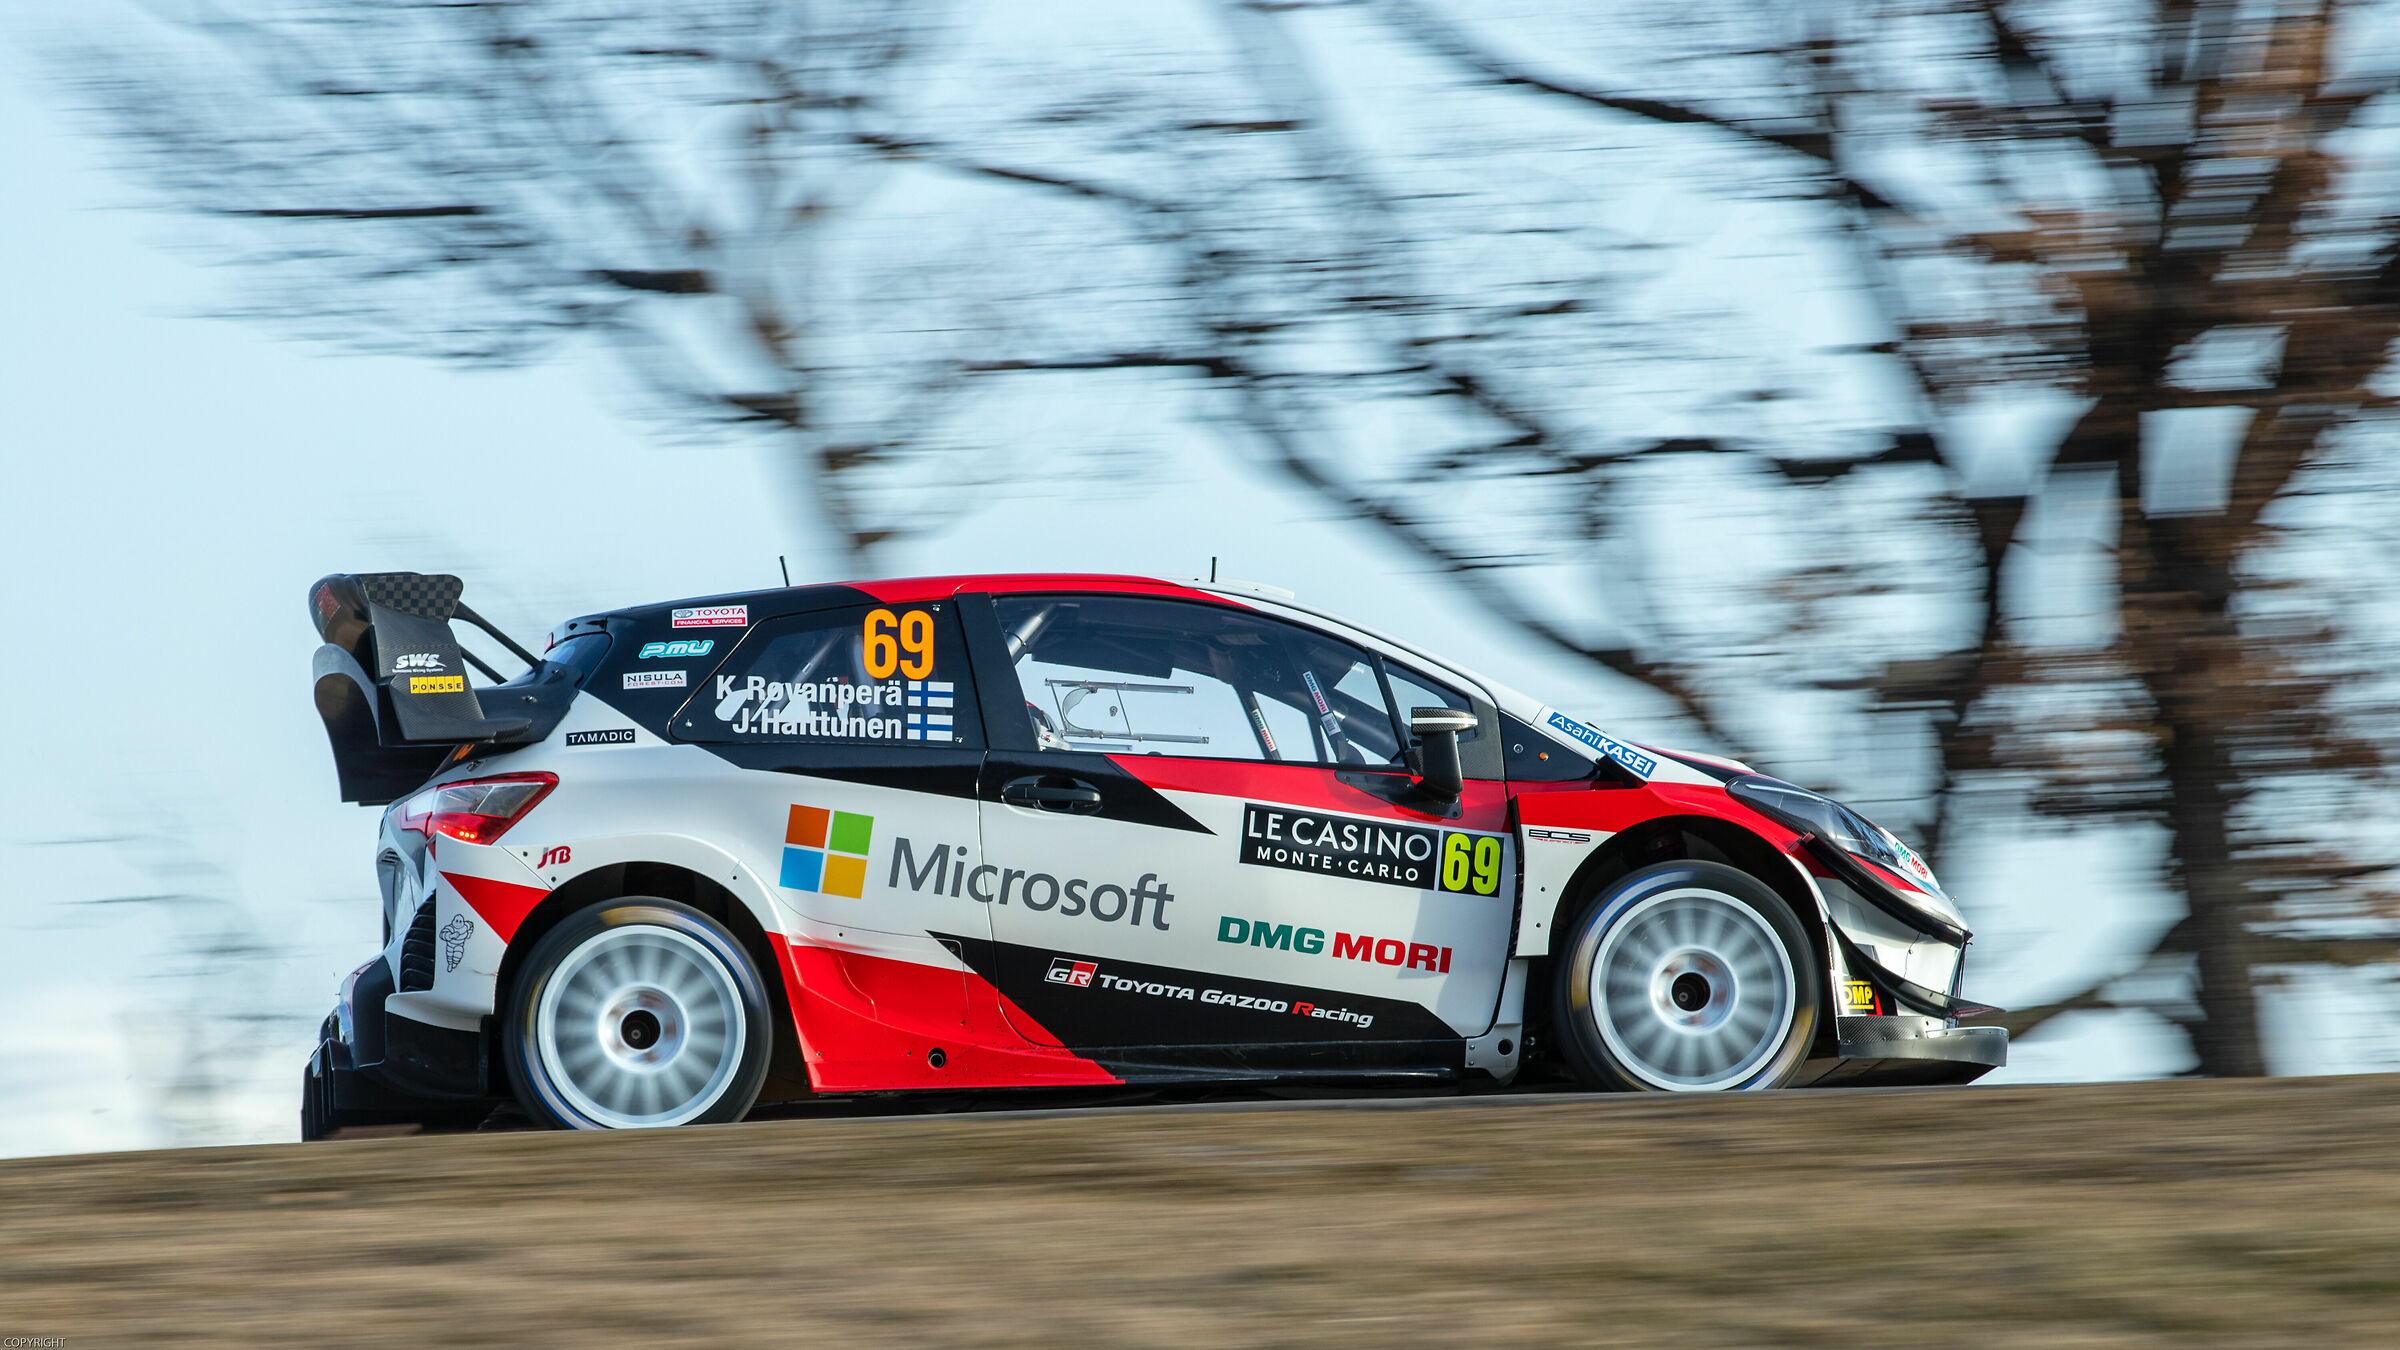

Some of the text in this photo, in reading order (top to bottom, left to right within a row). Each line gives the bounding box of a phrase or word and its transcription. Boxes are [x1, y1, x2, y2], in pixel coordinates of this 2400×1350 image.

[696, 608, 745, 616] TOYOTA
[396, 653, 444, 669] SWS
[863, 608, 935, 680] 69
[412, 682, 462, 691] PONSSE
[627, 673, 682, 682] NISULA
[716, 675, 902, 709] KRovanperä
[568, 731, 633, 744] TAMADIC
[1551, 716, 1653, 774] AsahiKASEI
[1248, 810, 1432, 862] LE CASINO
[537, 846, 571, 869] JTB
[1442, 832, 1501, 895] 69
[1911, 857, 1928, 879] MORI
[888, 837, 1175, 931] Microsoft
[1217, 916, 1452, 974] DMG MORI
[1048, 967, 1374, 1028] GR TOYOTA GAZOO Racing
